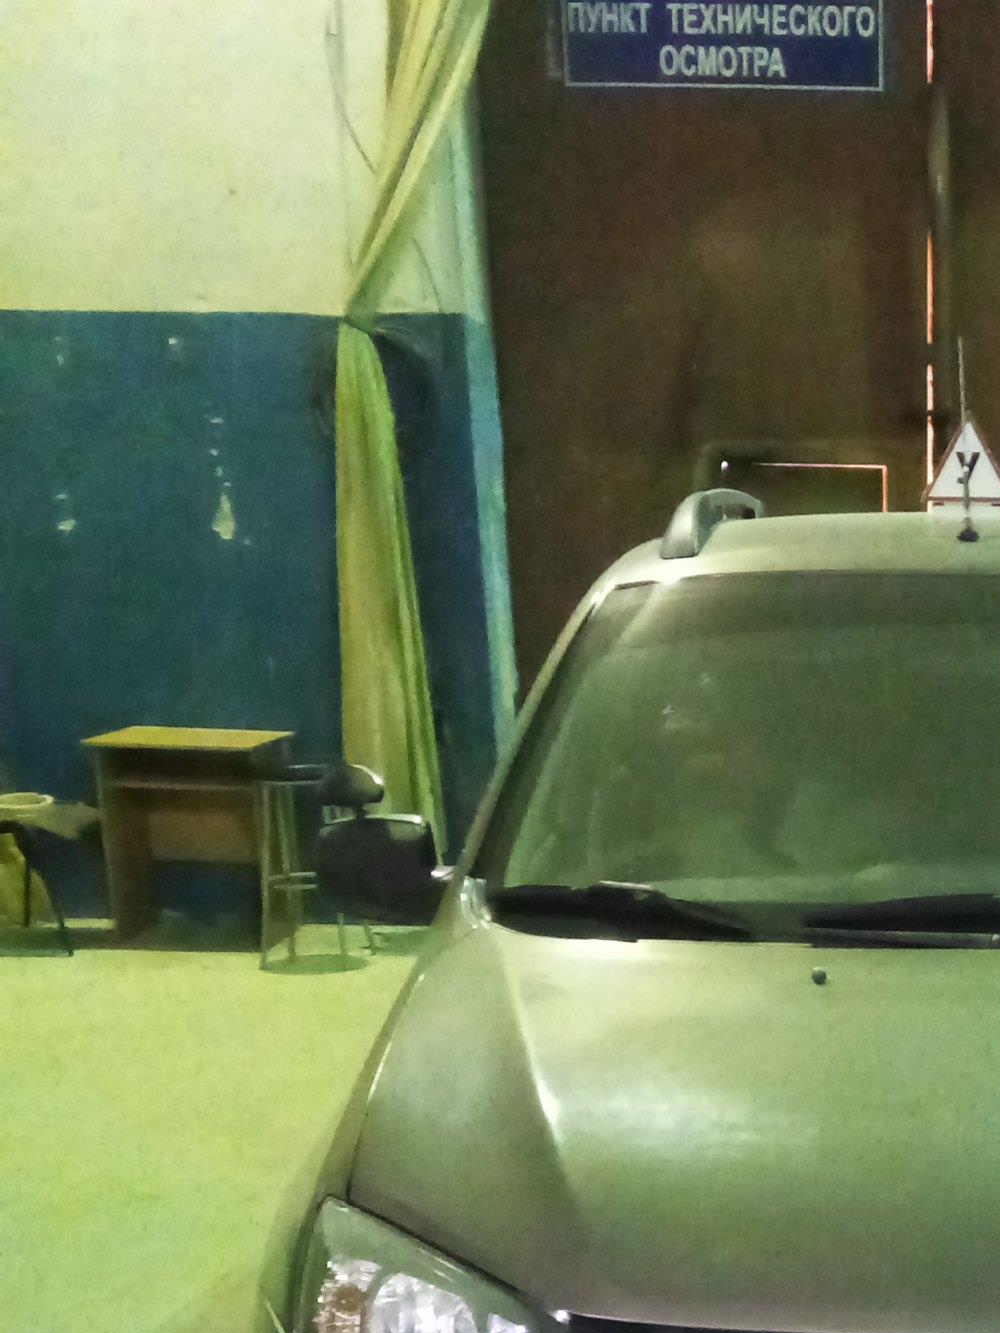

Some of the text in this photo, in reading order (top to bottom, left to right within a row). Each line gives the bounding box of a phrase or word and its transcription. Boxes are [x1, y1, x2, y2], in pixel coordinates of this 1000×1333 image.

[568, 2, 875, 38] ПУНКТ ТЕХНИЧЕСКОГО
[659, 44, 787, 78] ОСМОТРА
